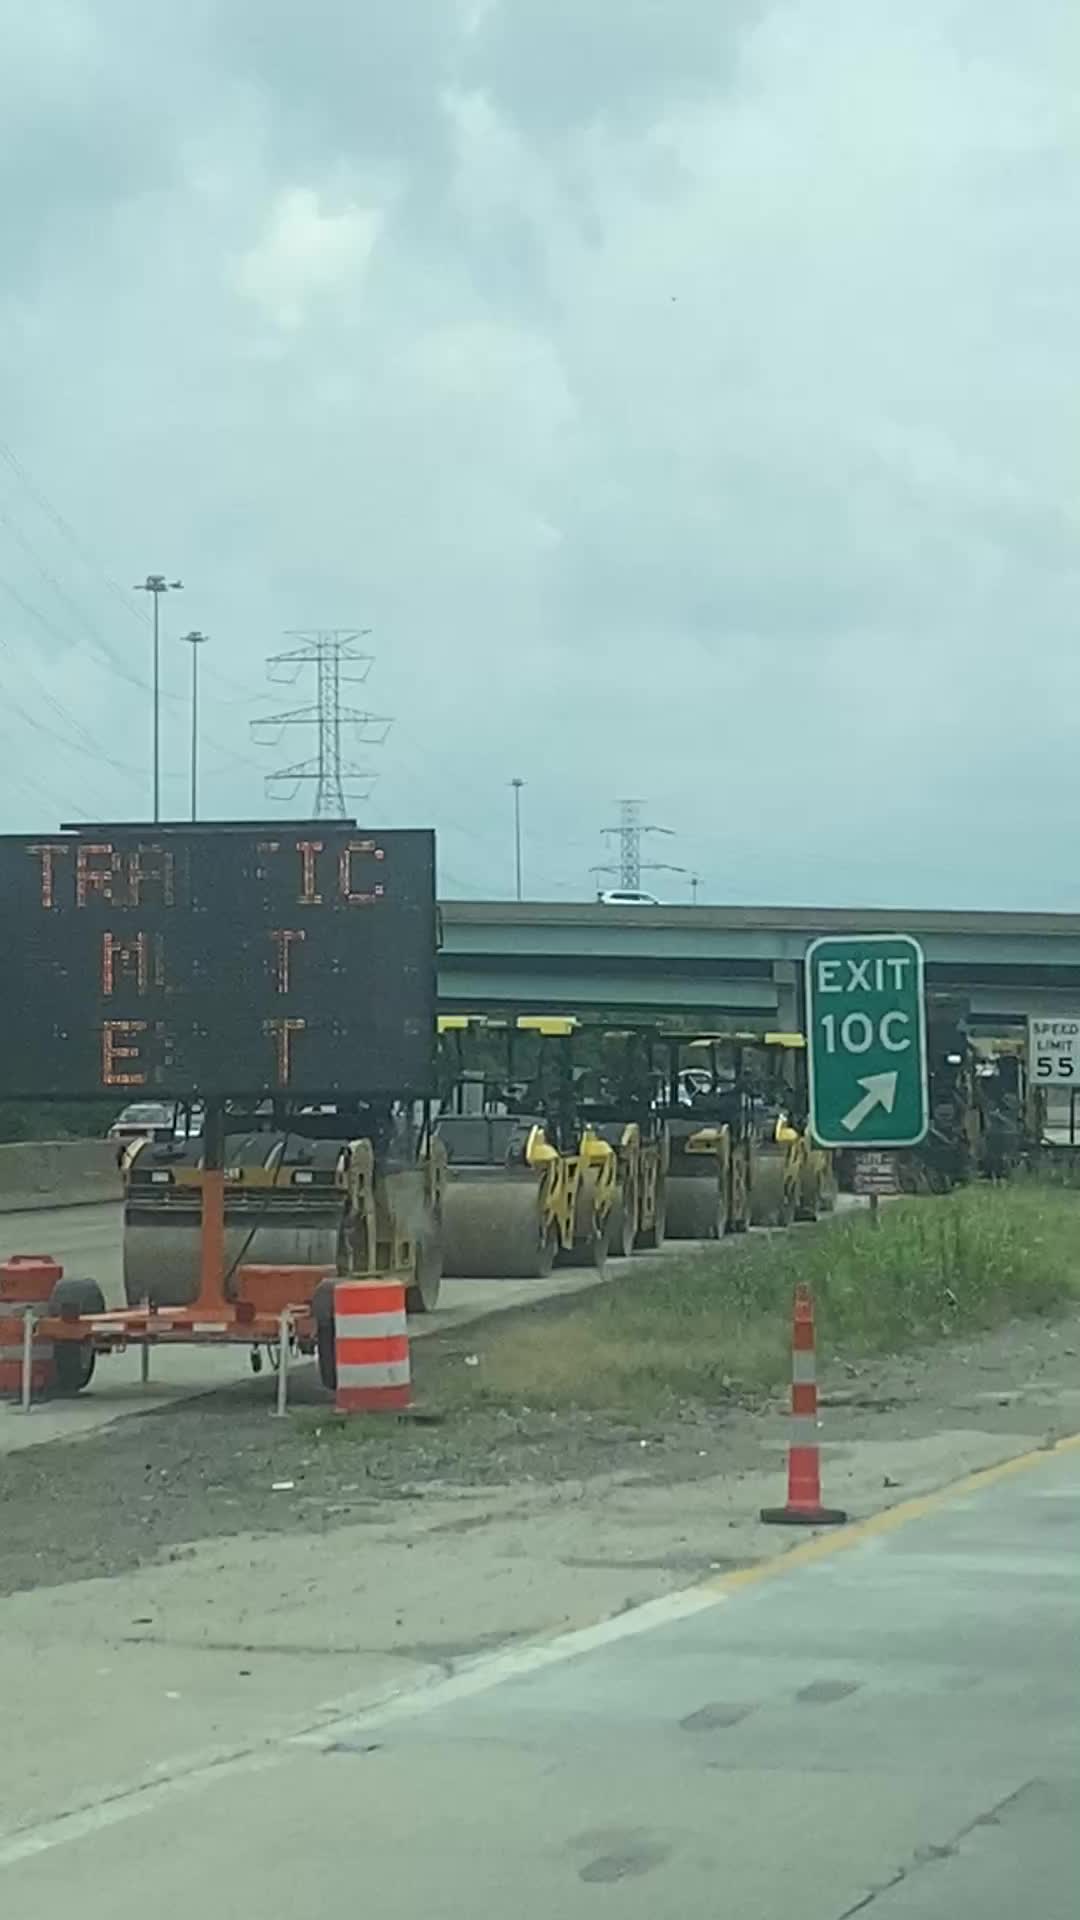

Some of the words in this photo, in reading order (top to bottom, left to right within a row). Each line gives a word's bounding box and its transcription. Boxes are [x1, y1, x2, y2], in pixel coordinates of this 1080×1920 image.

[26, 840, 385, 907] TRAIC
[818, 958, 910, 993] EXIT
[821, 1011, 911, 1053] 10C
[1033, 1022, 1079, 1035] SPEED
[1037, 1039, 1073, 1052] LIMIT
[1036, 1056, 1074, 1078] 55
